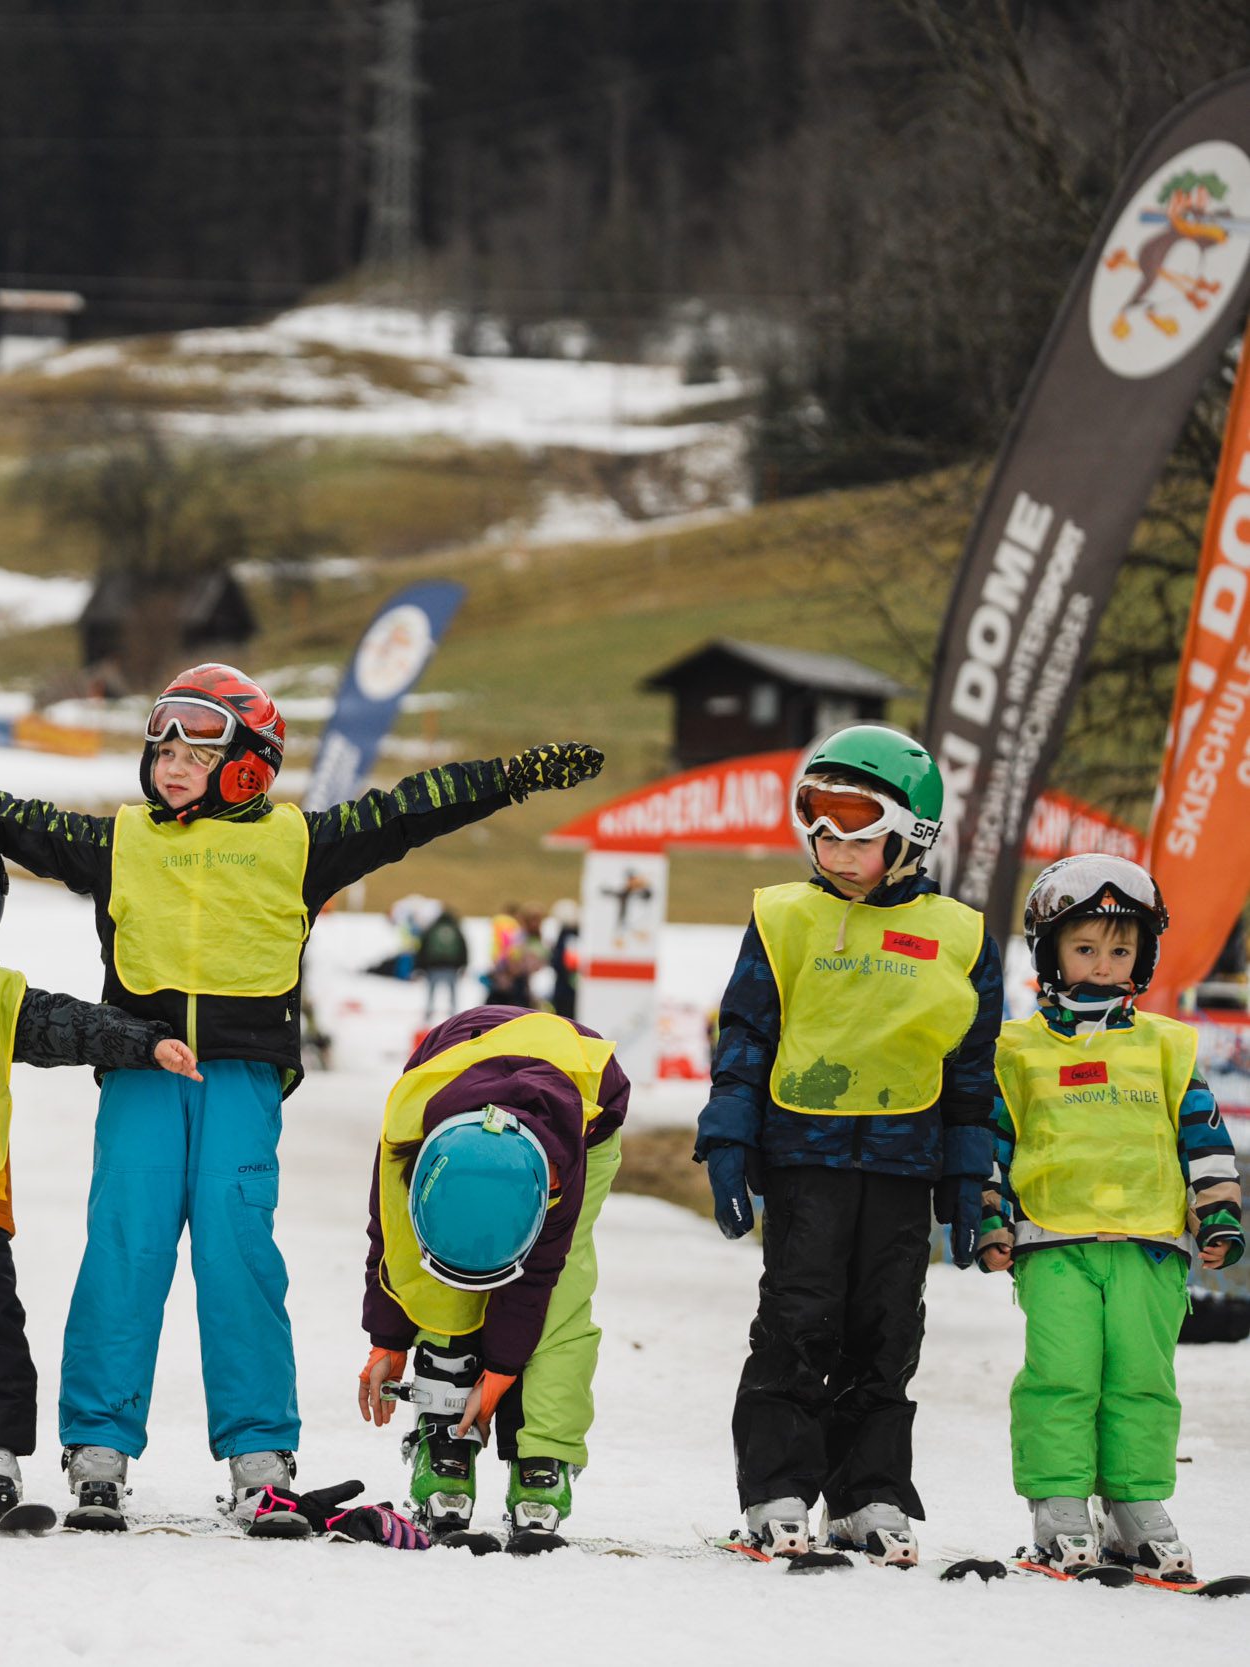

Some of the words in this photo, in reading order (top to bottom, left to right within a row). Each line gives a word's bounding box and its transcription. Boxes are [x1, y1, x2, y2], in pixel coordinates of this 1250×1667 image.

[951, 490, 1054, 729] DOME
[1005, 518, 1086, 702] INTERSPORT
[597, 770, 784, 838] KINDERLAND
[814, 957, 859, 971] SNOW
[875, 959, 918, 978] TRIBE
[1063, 1089, 1106, 1105] SNOW
[1121, 1089, 1160, 1104] TRIBE
[237, 1163, 274, 1174] O'NEILL
